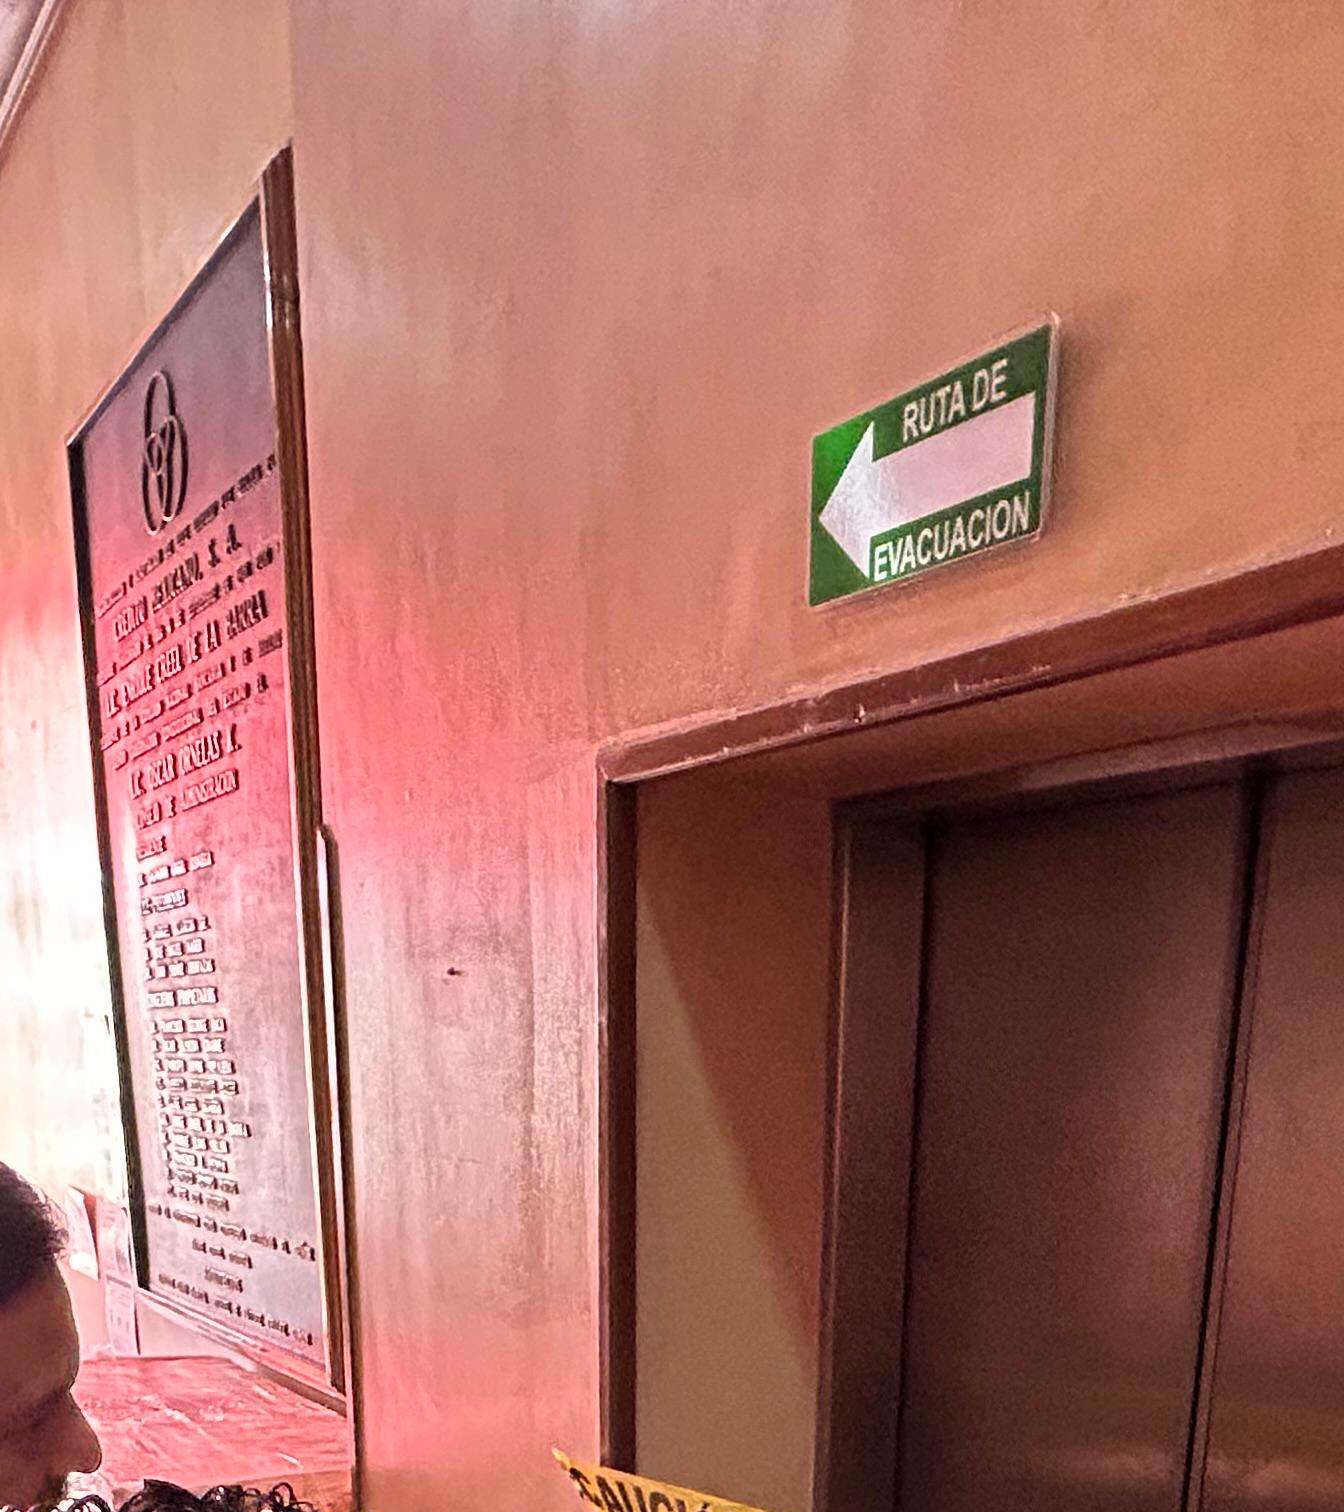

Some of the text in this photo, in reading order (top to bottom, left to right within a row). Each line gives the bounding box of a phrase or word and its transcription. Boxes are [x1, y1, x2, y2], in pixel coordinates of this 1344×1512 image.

[903, 359, 1008, 442] RUTA DE
[873, 491, 1031, 582] EVACUACION
